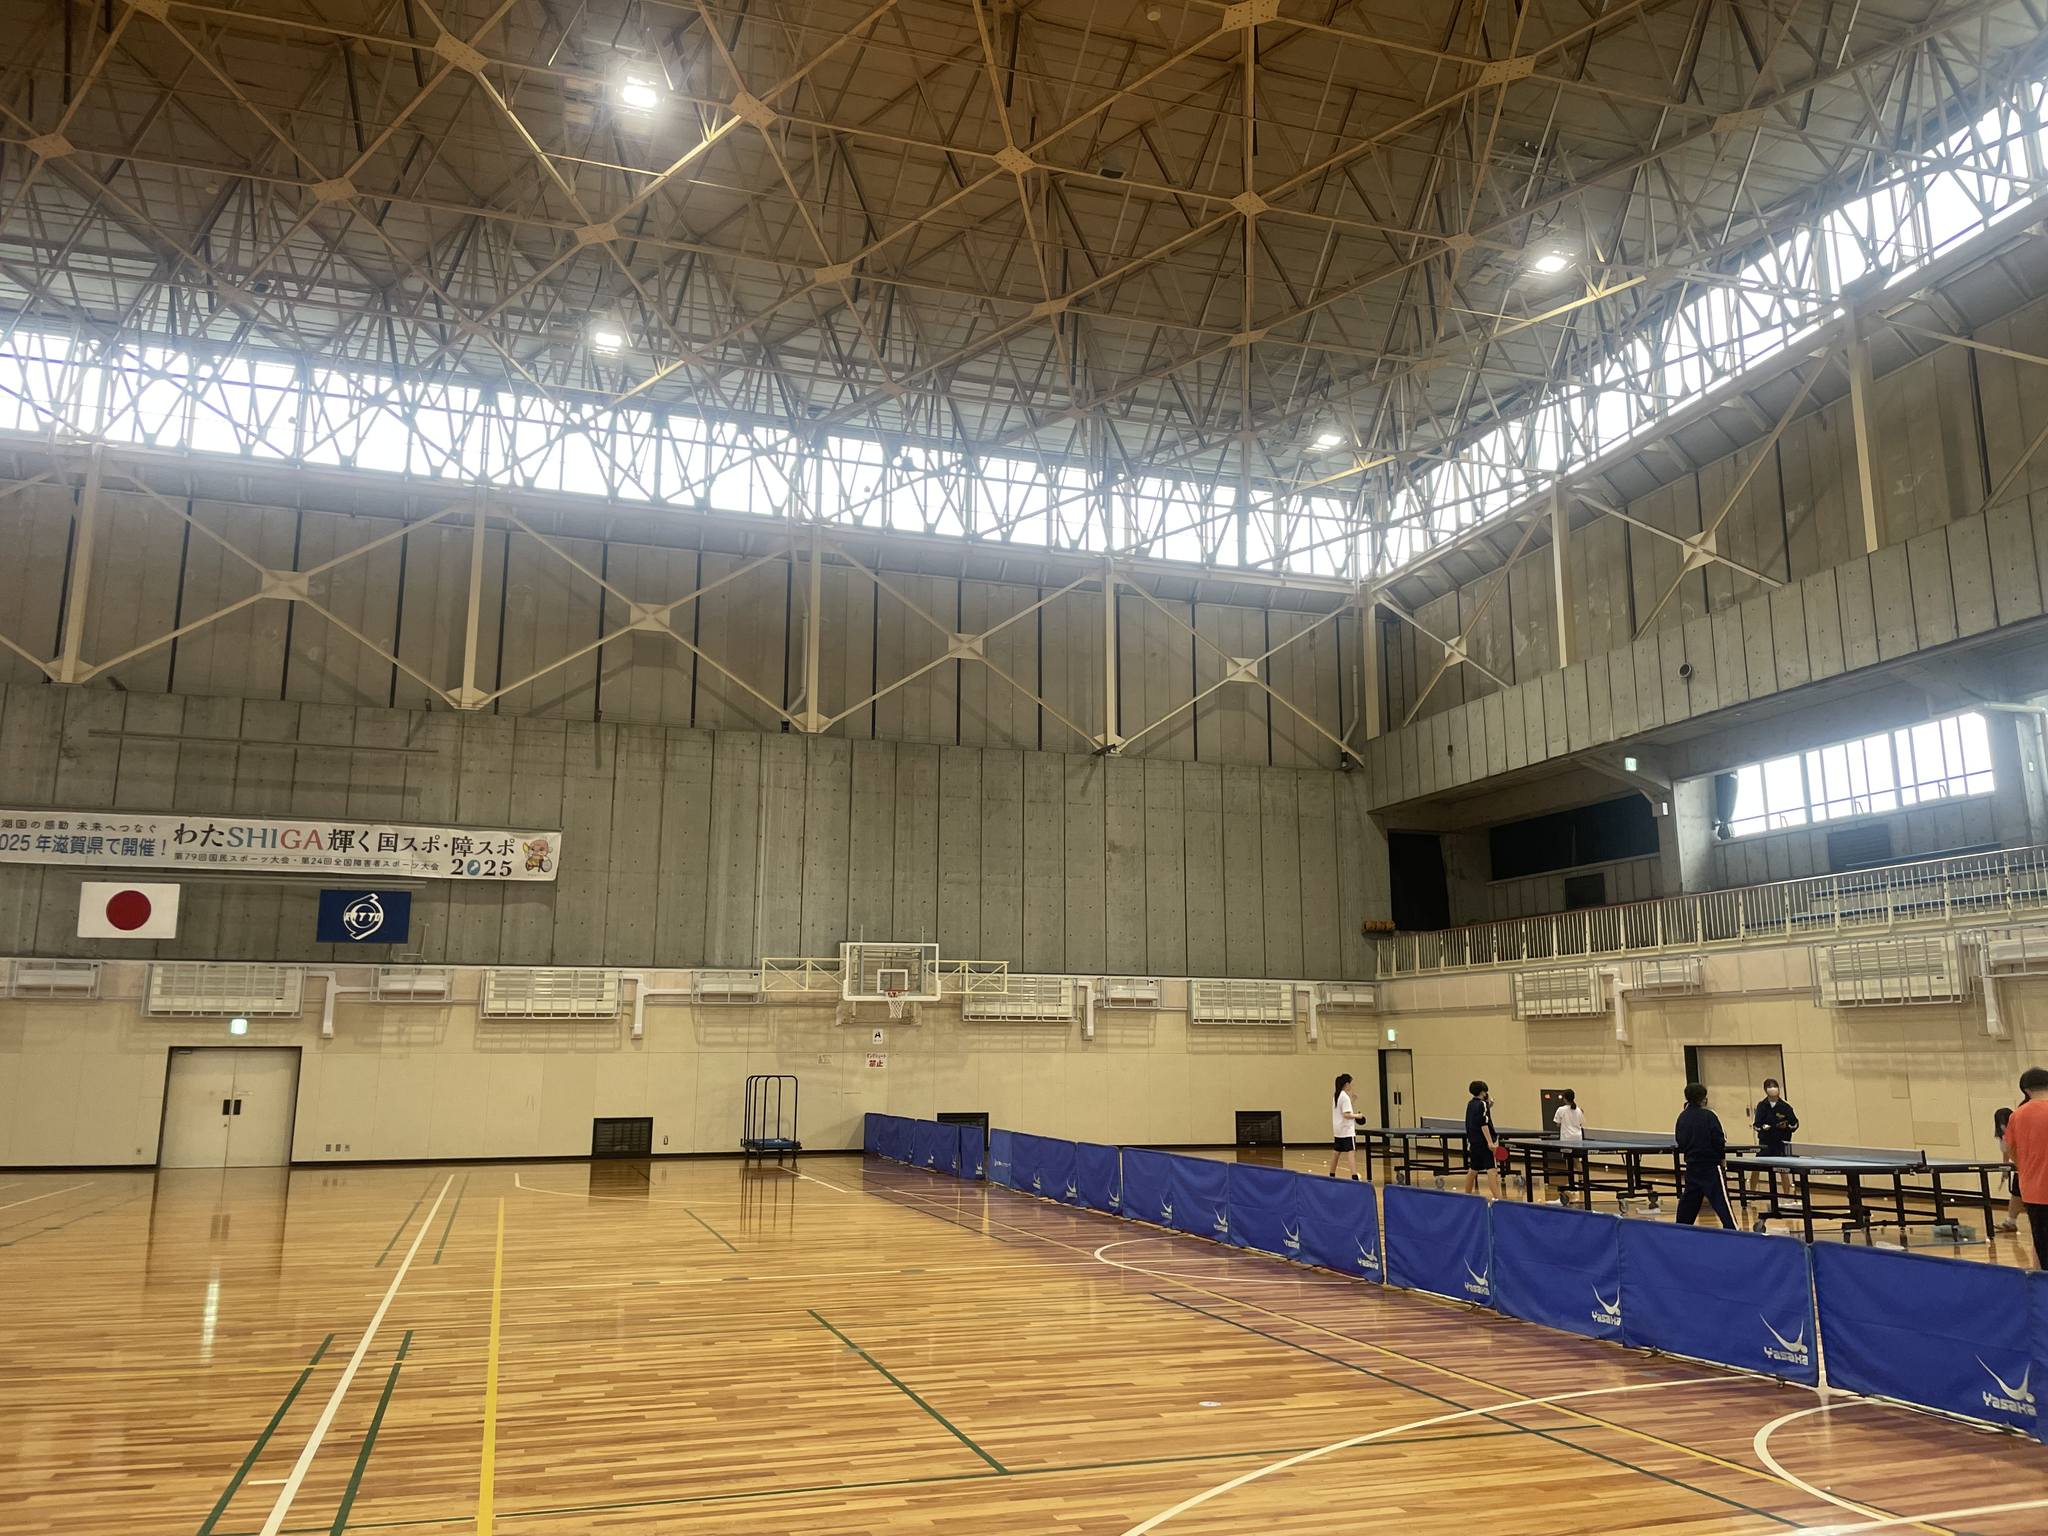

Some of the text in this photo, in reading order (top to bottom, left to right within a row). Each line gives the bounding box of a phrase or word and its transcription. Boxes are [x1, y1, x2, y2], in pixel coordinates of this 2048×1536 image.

[77, 822, 158, 833] 未来へつなぐ
[1591, 1310, 1622, 1326] Yasaka
[1763, 1346, 1809, 1366] Yasaka
[1982, 1391, 2038, 1417] Yasaka
